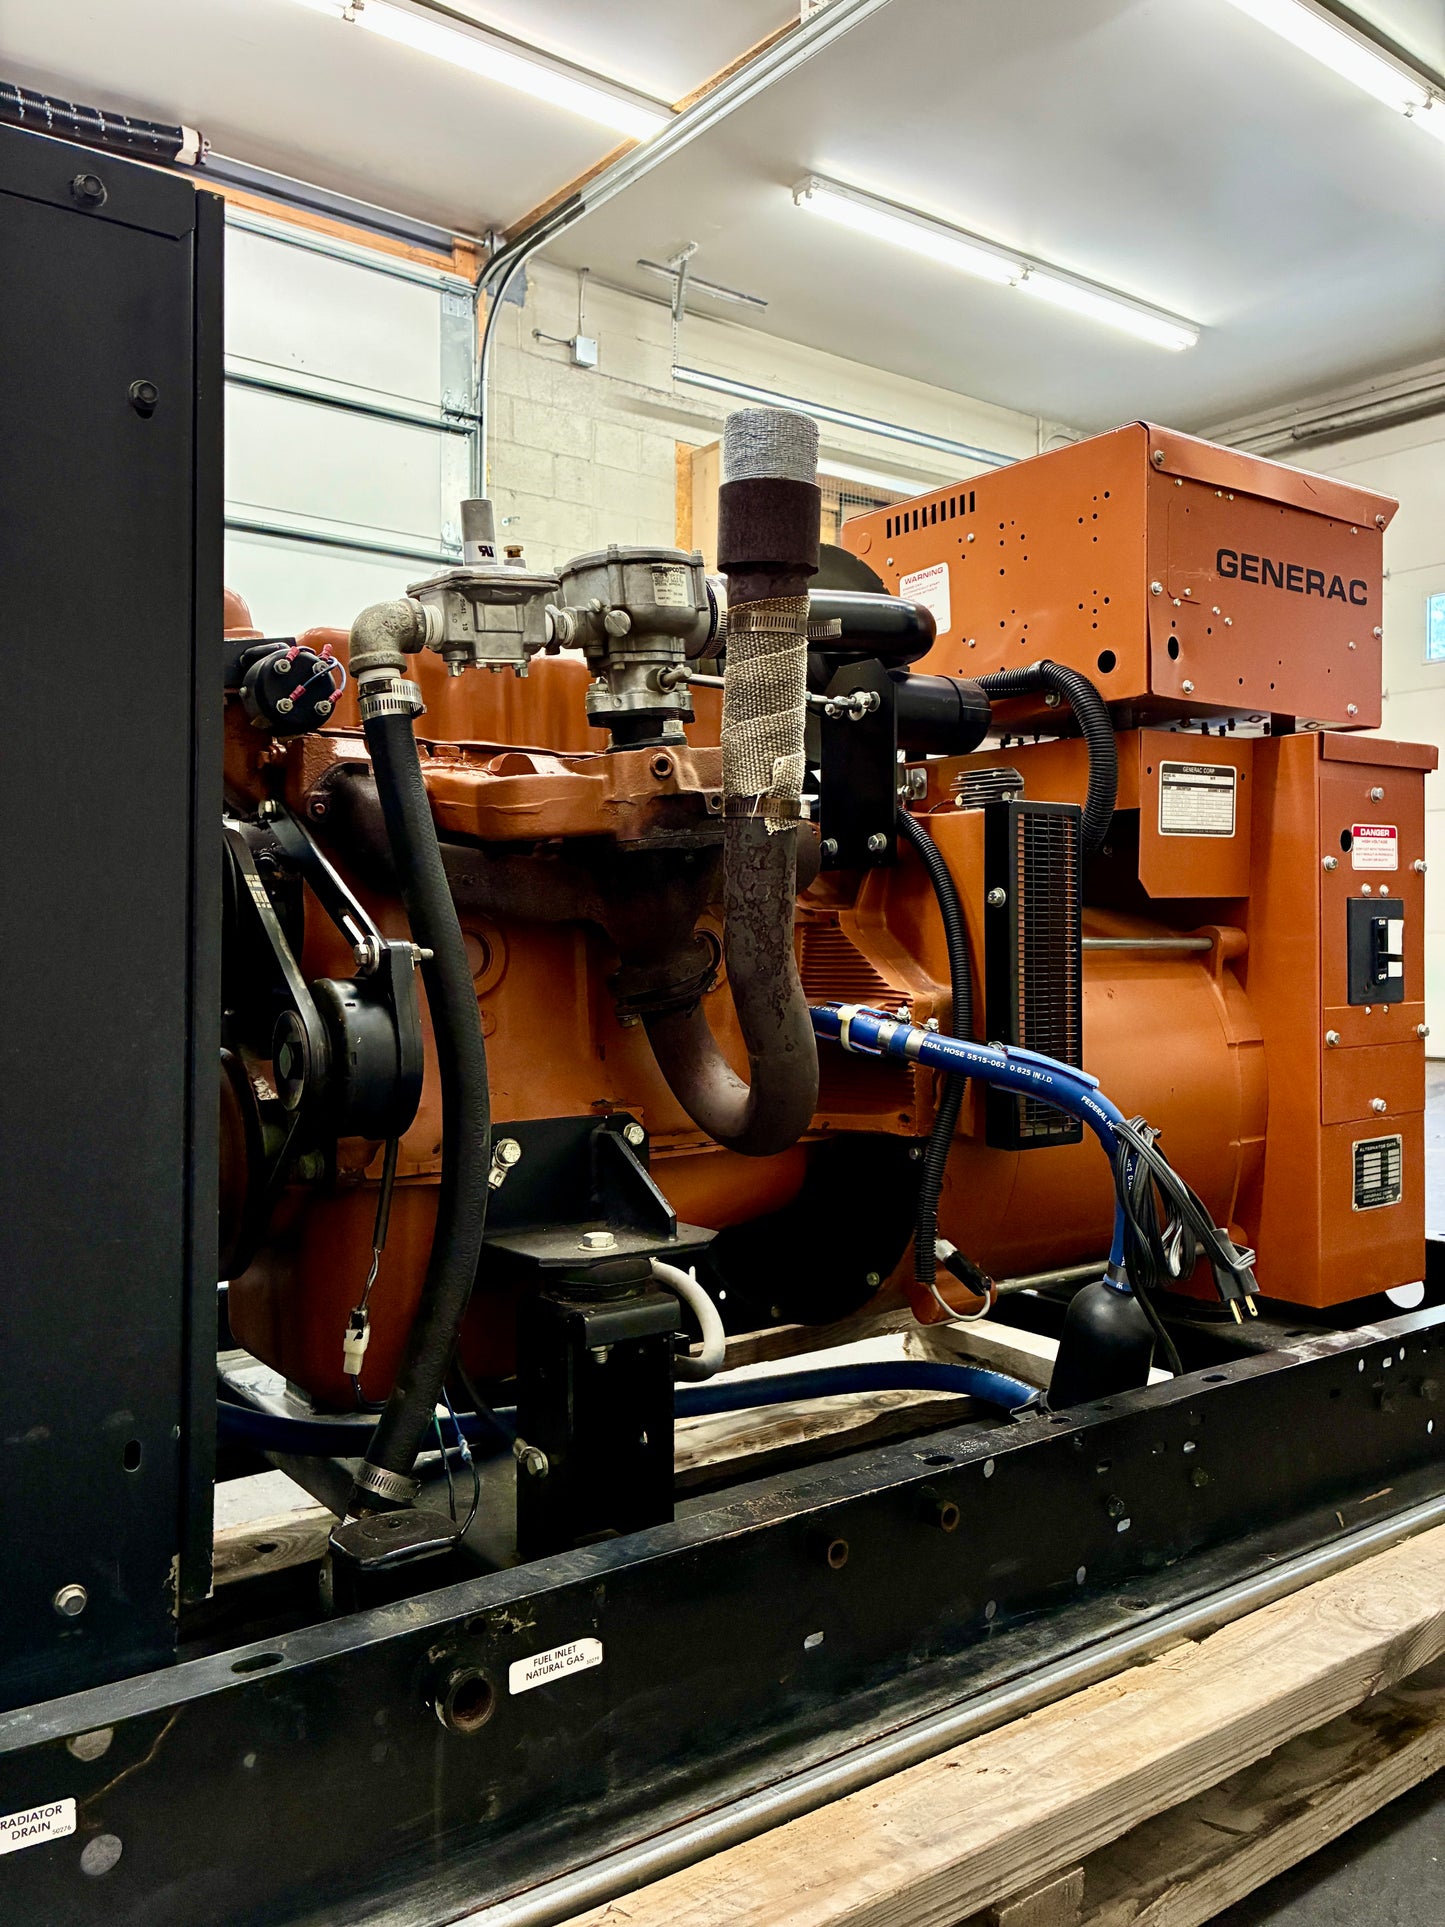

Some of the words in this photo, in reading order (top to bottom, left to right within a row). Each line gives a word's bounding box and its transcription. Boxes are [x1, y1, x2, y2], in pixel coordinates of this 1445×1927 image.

[904, 566, 944, 585] WARNING
[1216, 548, 1368, 606] GENERAC
[1182, 766, 1203, 774] GENERAC
[1360, 828, 1390, 837] DANGER
[922, 1040, 941, 1051] ERAL
[943, 1046, 965, 1058] HOSE
[967, 1052, 1006, 1069] 5515-062
[1009, 1065, 1031, 1076] 0.625
[1081, 1095, 1109, 1122] FEDERAL
[525, 1660, 565, 1681] NATURAL
[566, 1653, 585, 1666] GAS
[533, 1653, 553, 1667] FUEL
[555, 1644, 577, 1660] INLET
[0, 1804, 63, 1831] RADIATOR
[11, 1820, 51, 1841] DRAIN
[52, 1825, 72, 1836] 50276
